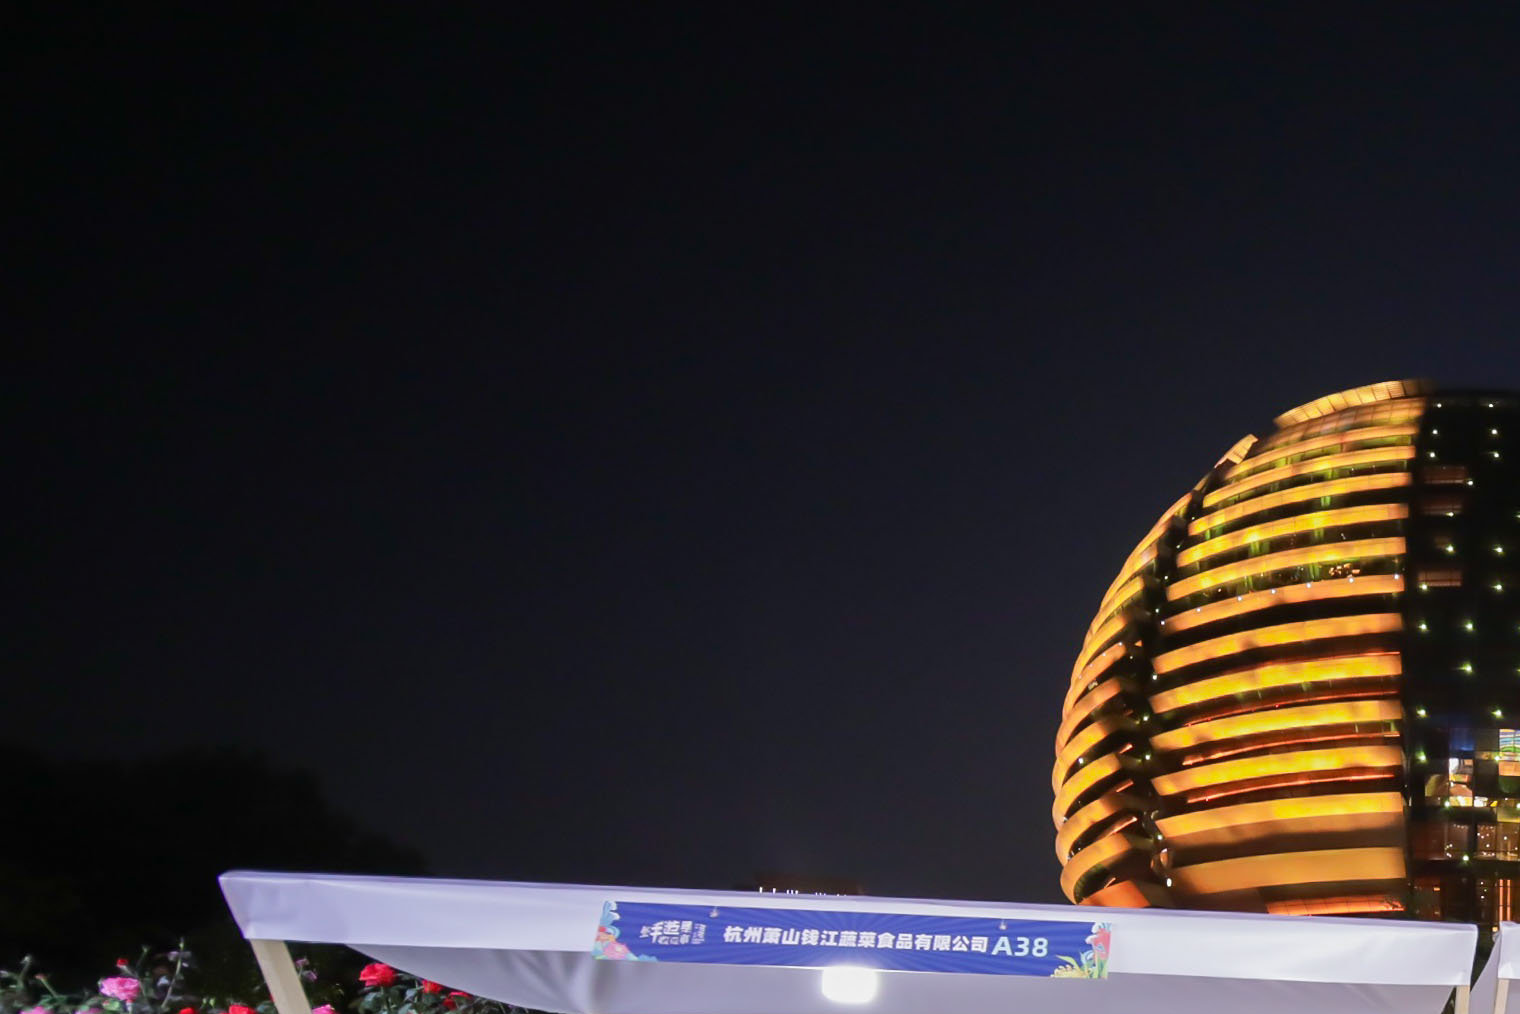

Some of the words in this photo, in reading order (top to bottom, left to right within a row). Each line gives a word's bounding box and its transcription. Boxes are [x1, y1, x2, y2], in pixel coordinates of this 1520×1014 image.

[723, 925, 988, 953] 杭州萧山钱江蔬菜食品有限公司
[991, 936, 1049, 957] A38
